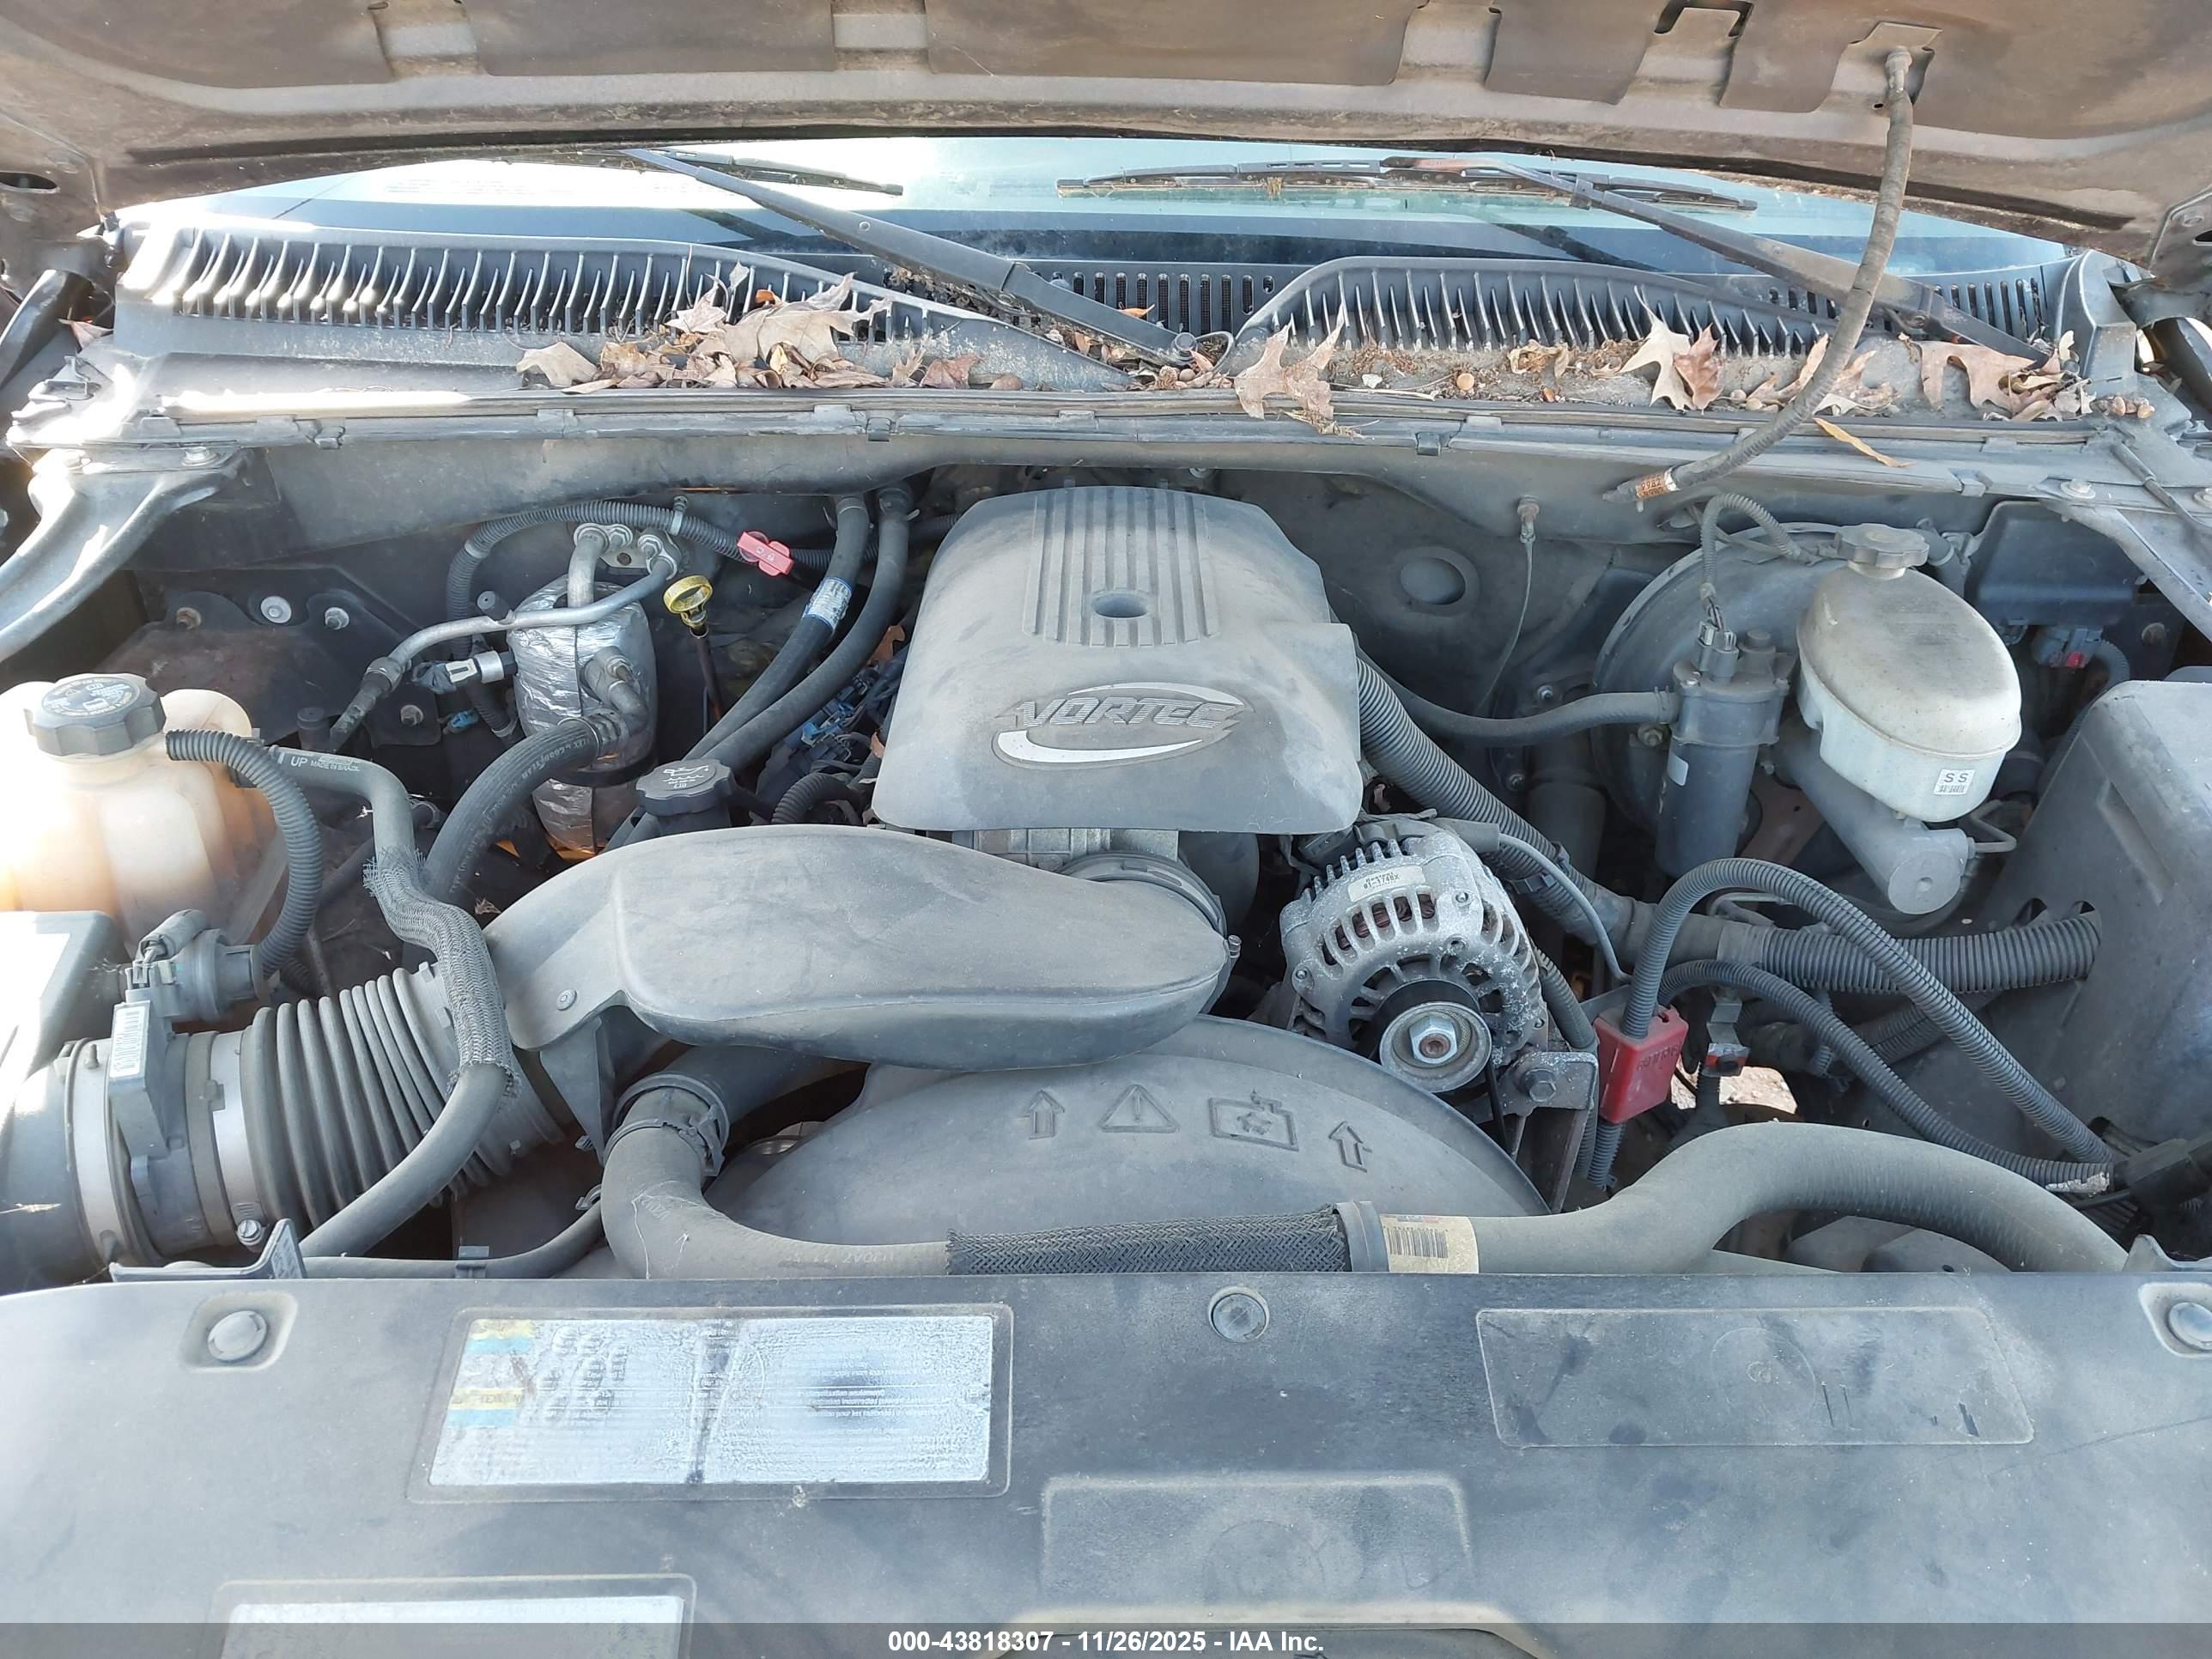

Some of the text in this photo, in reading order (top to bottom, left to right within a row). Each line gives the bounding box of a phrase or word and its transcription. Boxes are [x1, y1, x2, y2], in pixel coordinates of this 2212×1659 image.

[1018, 696, 1239, 728] VORTEC
[290, 756, 308, 768] UP
[310, 760, 330, 769] MADE
